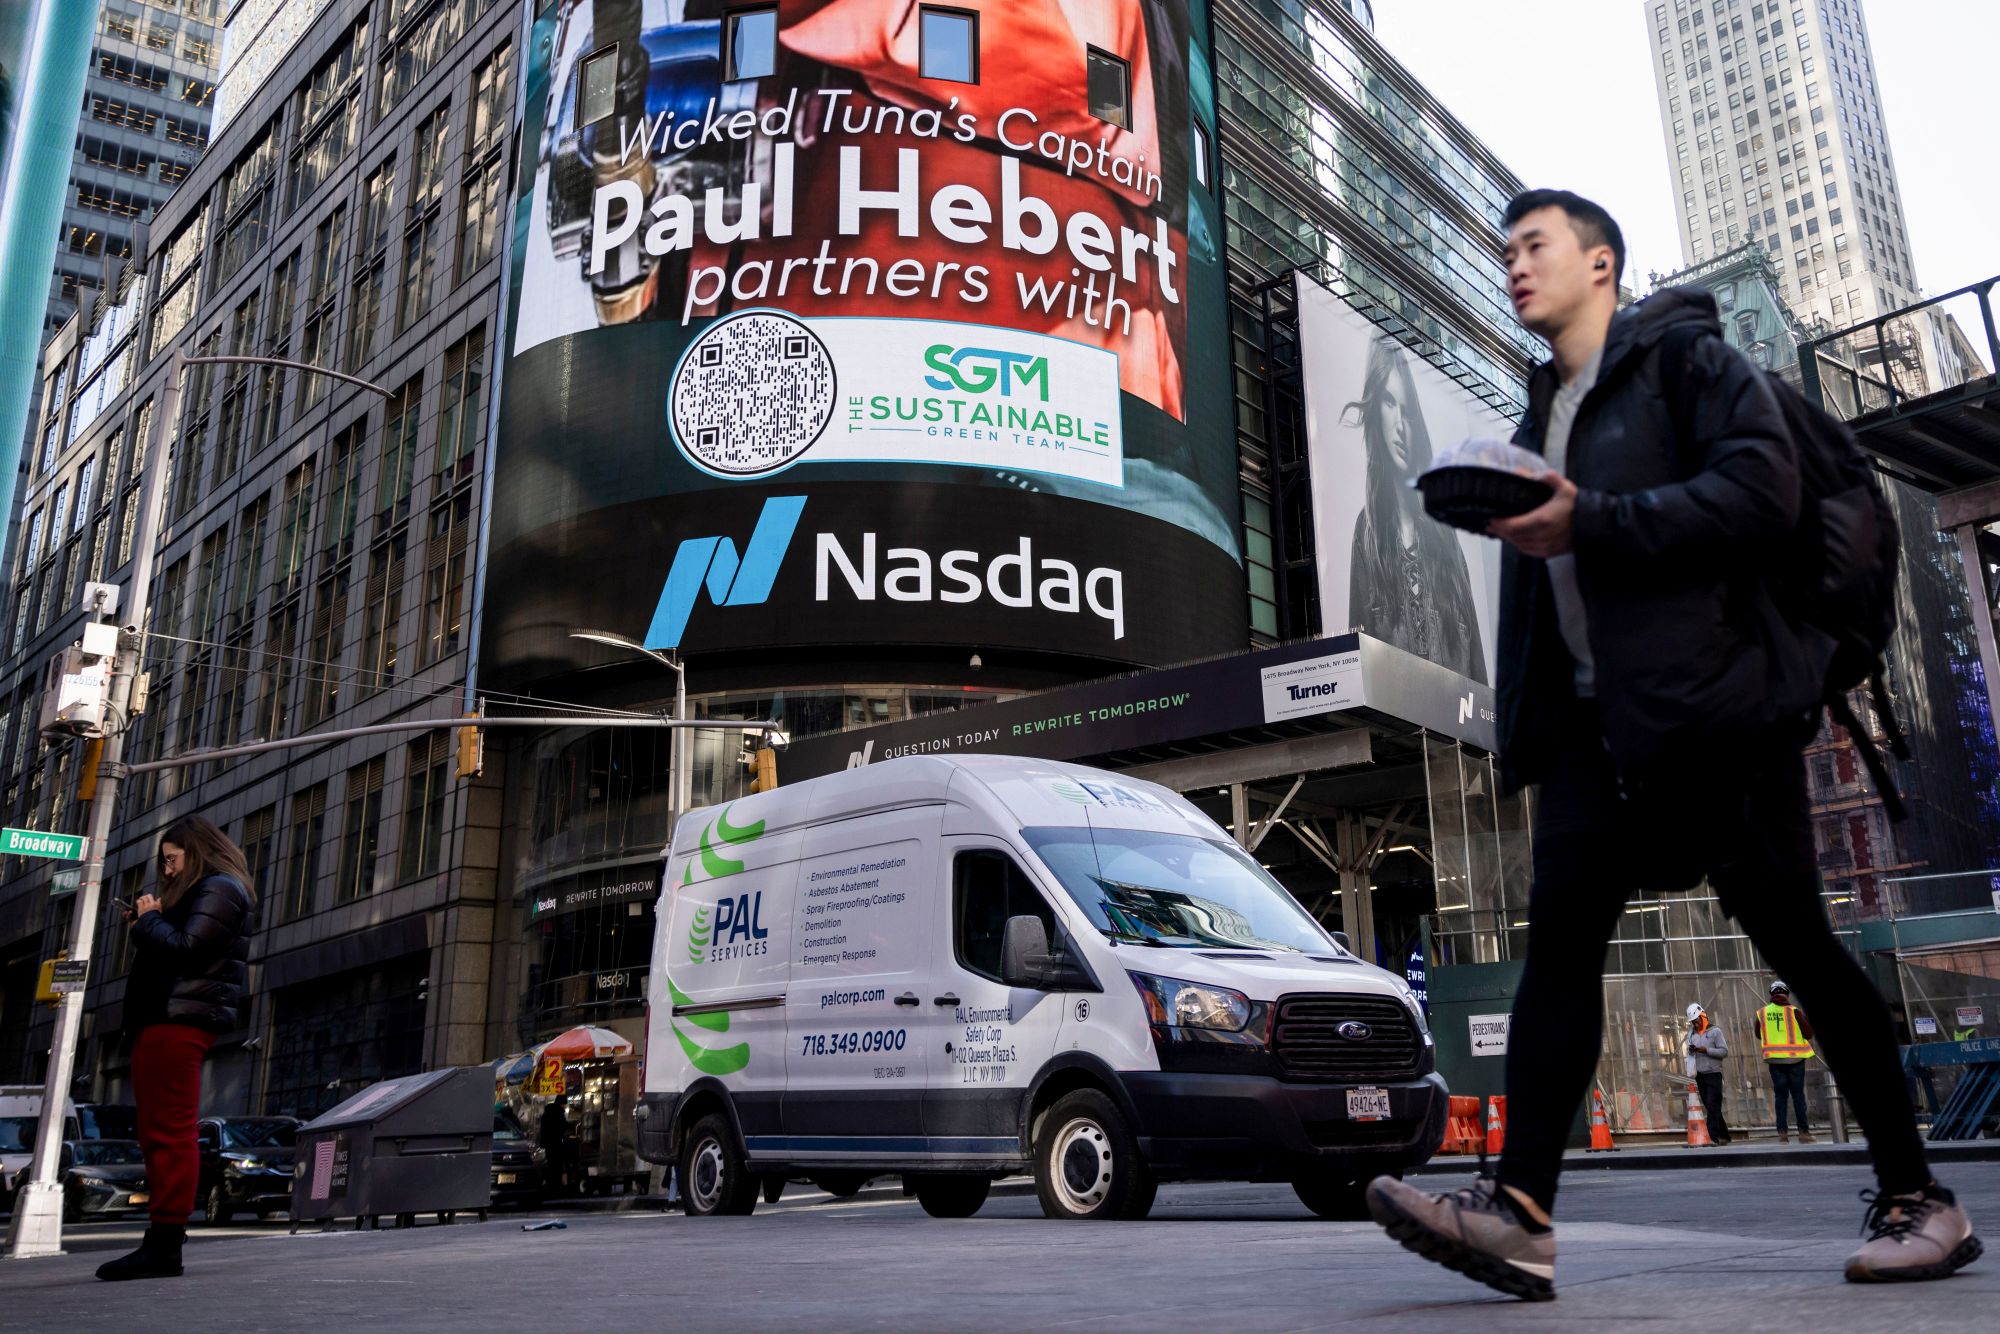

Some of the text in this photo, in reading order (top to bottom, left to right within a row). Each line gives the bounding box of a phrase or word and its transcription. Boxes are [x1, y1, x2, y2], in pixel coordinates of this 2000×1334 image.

[619, 87, 1163, 202] Wicked Tuna's Captain
[590, 142, 1180, 304] Paul Hebert
[681, 239, 1132, 336] partners with
[924, 343, 1050, 403] SGTM
[848, 395, 864, 434] THE
[869, 395, 1110, 447] SUSTAINABLE
[926, 425, 1066, 451] GREEN TEAM
[815, 532, 1125, 641] Nasdaq
[1277, 669, 1304, 678] Broadway
[1304, 665, 1317, 673] New
[1318, 662, 1332, 670] York,
[1333, 660, 1341, 668] NY
[1342, 656, 1359, 665] 10036
[1286, 681, 1338, 701] Turner
[884, 737, 951, 759] QUESTION
[956, 728, 1000, 747] TODAY
[1012, 712, 1083, 737] REWRITE
[9, 831, 73, 858] Broadway
[810, 857, 906, 882] Environmental Remediation
[538, 880, 654, 912] Nasdaq REWRITE TOMORROW
[808, 878, 880, 898] Asbestos Abatement
[806, 892, 905, 916] Spray Fireproofing/Coatings
[712, 890, 769, 947] PAL
[804, 919, 842, 932] Demolition
[711, 940, 767, 963] SERVICES
[803, 934, 847, 948] Construction
[803, 949, 877, 966] Emergency Response
[596, 970, 630, 989] Nasdaq
[821, 988, 885, 1010] palcorp.com
[1077, 1002, 1087, 1018] 16
[955, 1003, 1013, 1024] PAL Environmental
[965, 1025, 1001, 1045] Safety Corp
[1472, 1021, 1506, 1036] PEDESTRIANS
[802, 1028, 907, 1056] 718.349.0900
[1960, 1040, 1982, 1053] POLICE
[968, 1046, 991, 1064] Queens
[992, 1047, 1010, 1062] Plaza
[873, 1067, 886, 1079] DEC
[979, 1065, 990, 1082] NY
